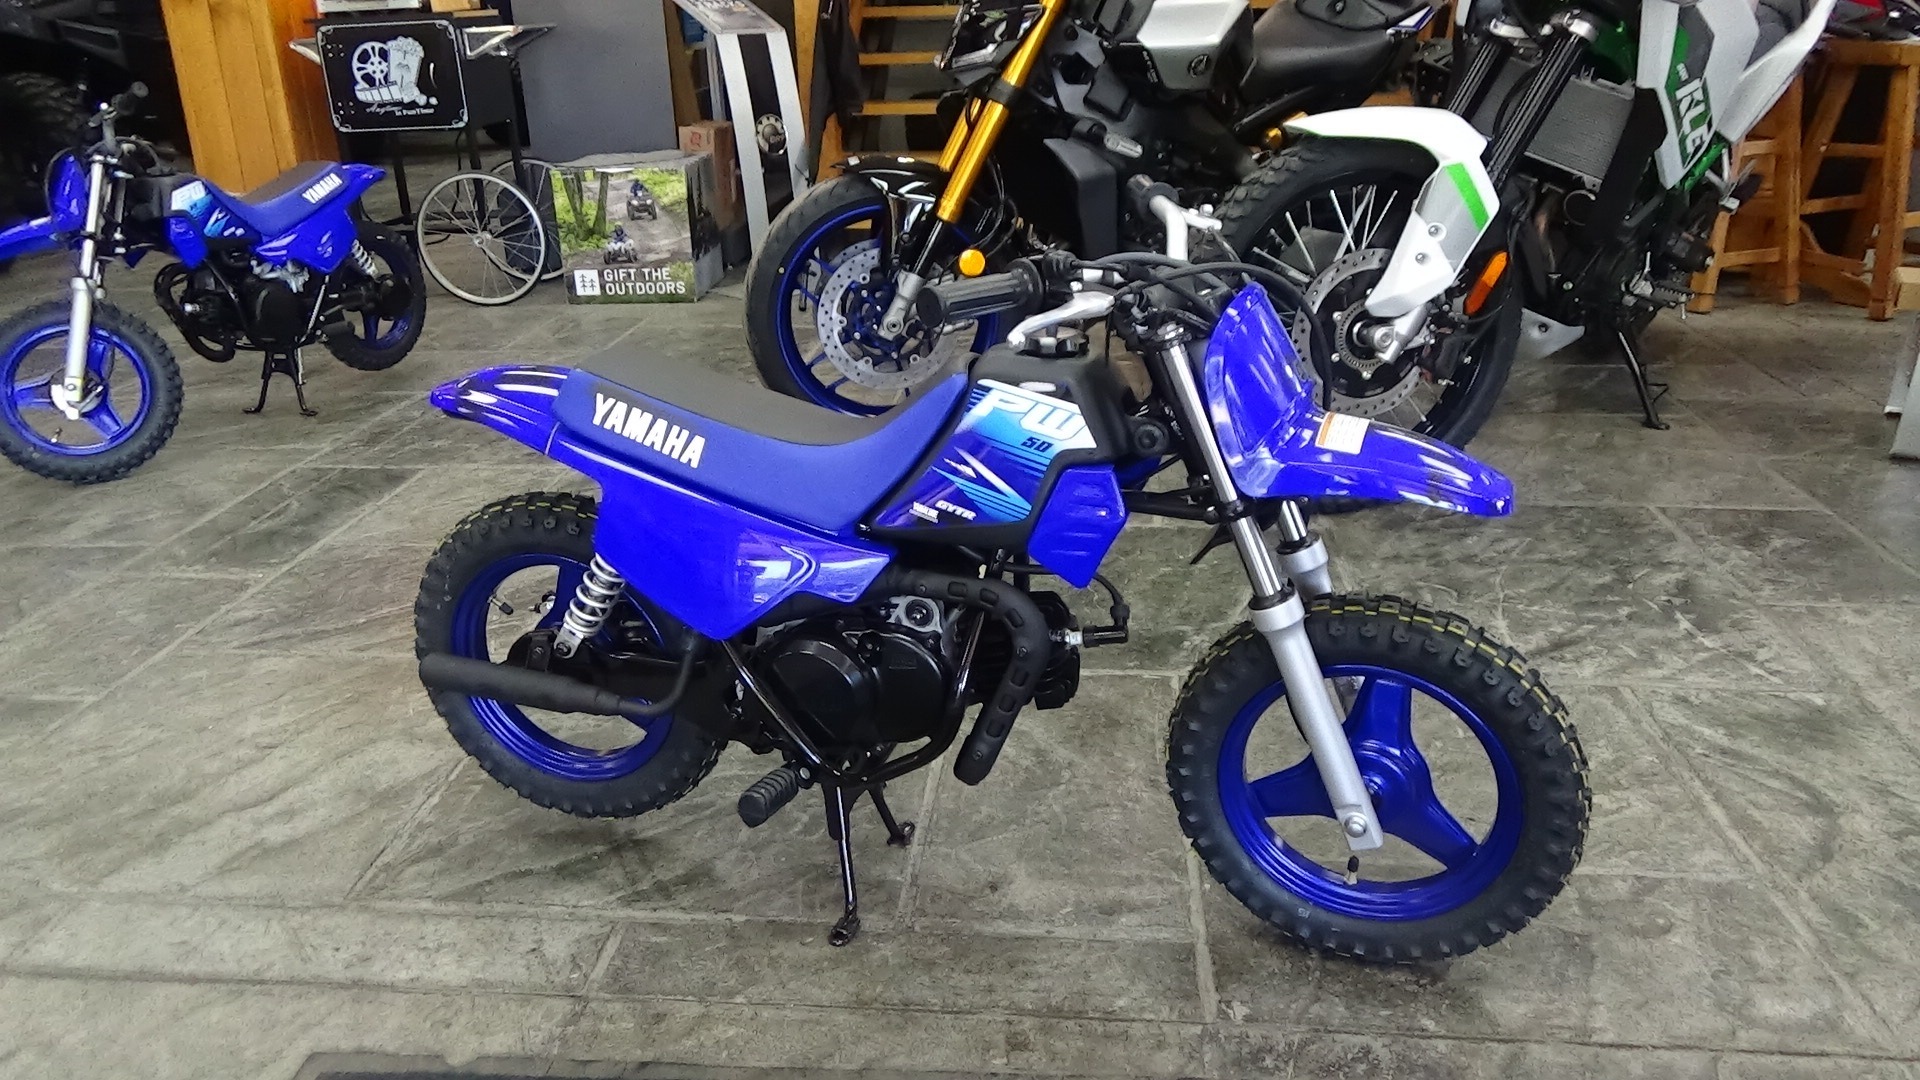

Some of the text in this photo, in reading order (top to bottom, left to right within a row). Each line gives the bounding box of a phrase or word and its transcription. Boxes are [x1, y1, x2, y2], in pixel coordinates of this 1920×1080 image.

[302, 172, 343, 204] YAMAHA
[603, 267, 671, 281] GIFT THE
[605, 281, 686, 295] OUTDOORS
[962, 387, 1087, 441] PW
[592, 392, 706, 469] YAMAHA
[1020, 436, 1054, 453] 50
[934, 500, 977, 521] GYTR
